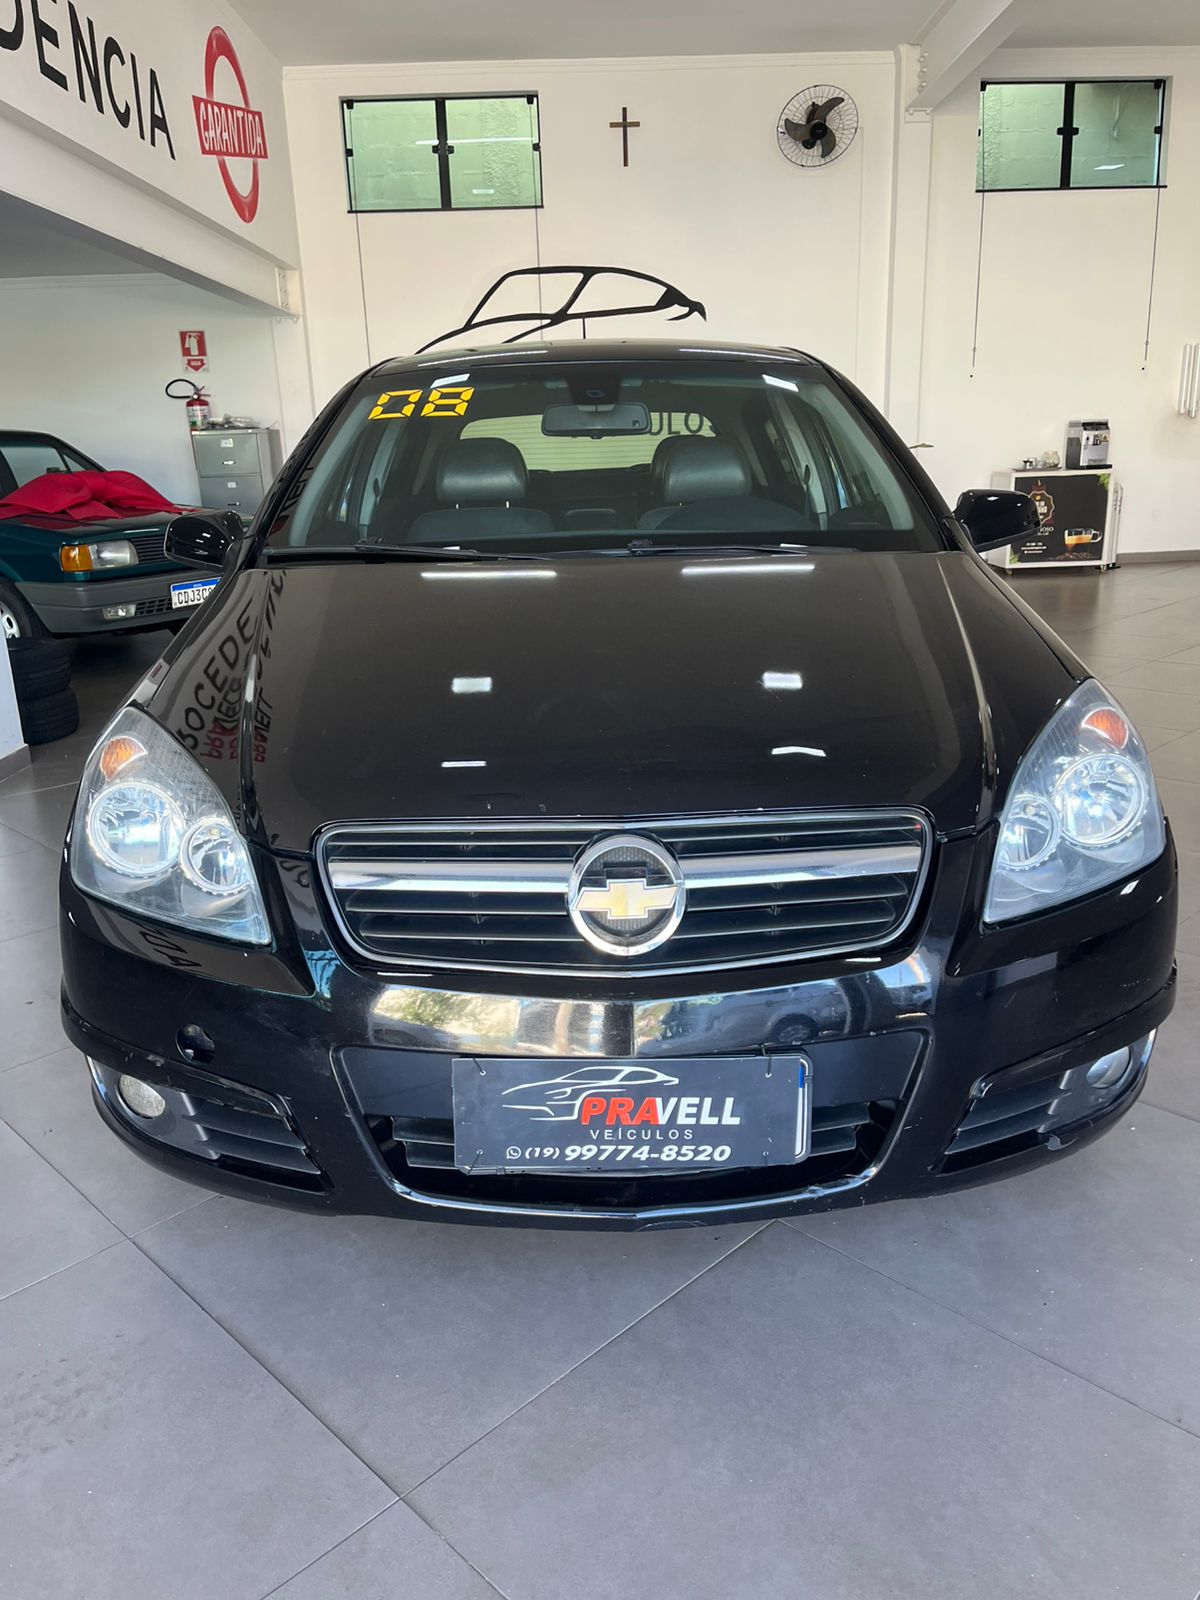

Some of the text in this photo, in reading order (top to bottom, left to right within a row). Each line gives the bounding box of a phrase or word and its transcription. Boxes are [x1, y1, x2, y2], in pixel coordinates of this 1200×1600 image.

[200, 101, 265, 156] GARANTIDA
[368, 386, 475, 420] 08
[649, 412, 713, 436] ULO
[580, 1097, 741, 1126] PRAVELL
[590, 1127, 694, 1141] VEÍCULOS
[525, 1144, 732, 1162] (19) 99774-8520
